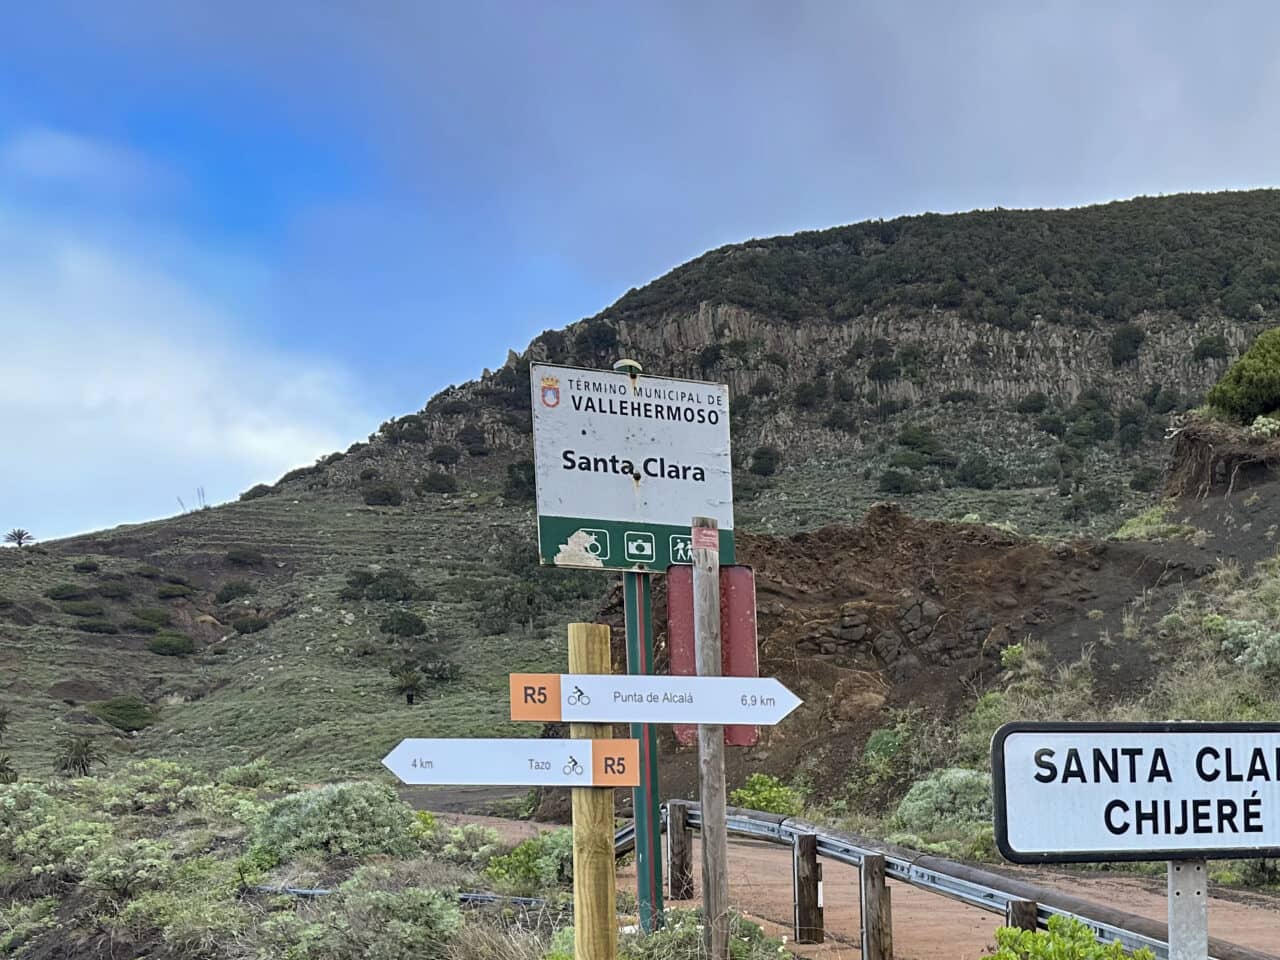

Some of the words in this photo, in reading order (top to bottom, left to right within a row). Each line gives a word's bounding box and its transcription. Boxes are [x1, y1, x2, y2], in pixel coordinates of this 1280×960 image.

[571, 394, 719, 425] VALLEHERMOSO
[633, 386, 702, 404] MUNICIPAL
[707, 395, 722, 406] DE
[562, 450, 634, 476] Santa
[643, 457, 706, 481] Clara
[523, 686, 547, 704] R5
[613, 691, 643, 703] Punta
[646, 692, 659, 703] de
[740, 694, 757, 706] 6,9
[760, 695, 775, 707] km
[411, 758, 417, 769] 4
[419, 758, 433, 769] km
[528, 759, 551, 770] Tazo
[604, 757, 625, 774] R5
[1033, 747, 1173, 784] SANTA
[1104, 790, 1264, 836] CHIJERÉ
